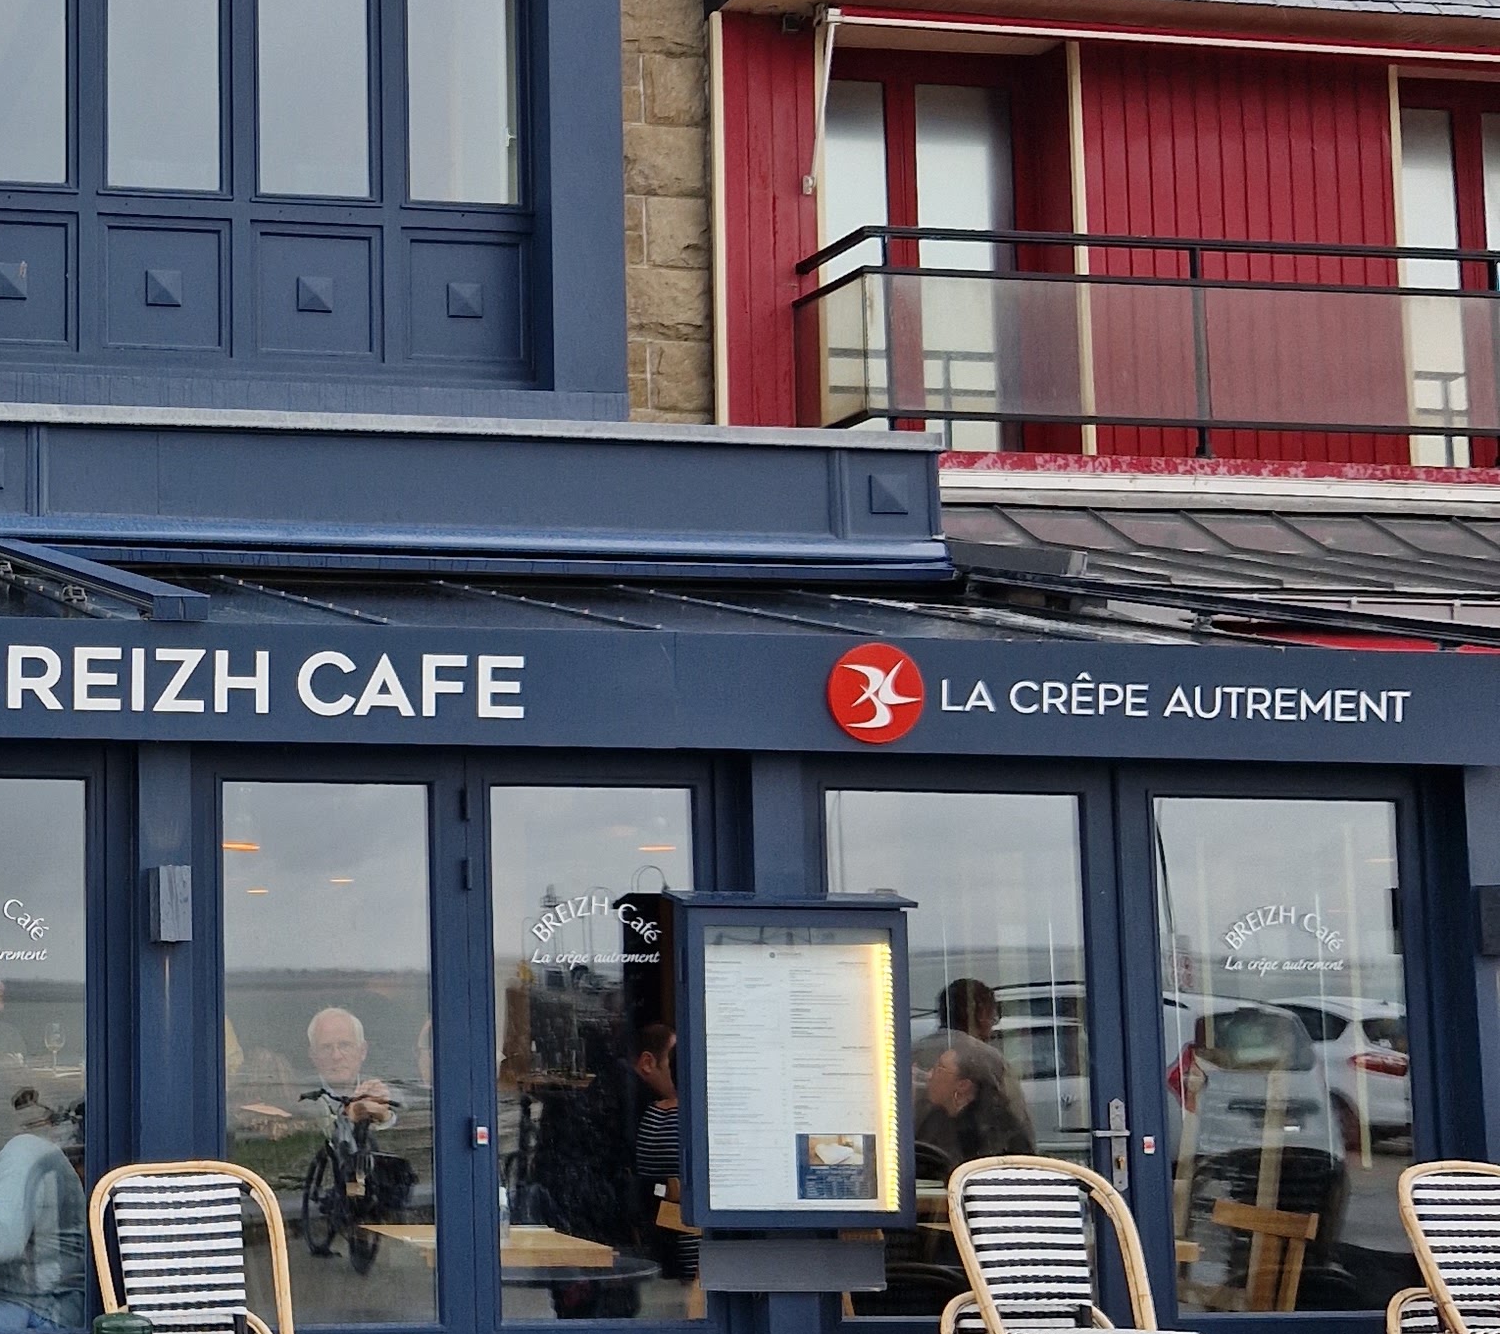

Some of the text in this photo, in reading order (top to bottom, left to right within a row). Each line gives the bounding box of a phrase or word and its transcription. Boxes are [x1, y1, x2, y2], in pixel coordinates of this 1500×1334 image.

[297, 650, 525, 719] CAFE
[940, 671, 1411, 724] LA CRÊPE AUTREMENT
[3, 898, 50, 942] Café
[531, 895, 662, 945] BREIZH Café
[1224, 905, 1344, 953] BREIZH Café
[530, 948, 661, 971] La crêpe autrement
[1225, 955, 1344, 977] La crêpe autrement
